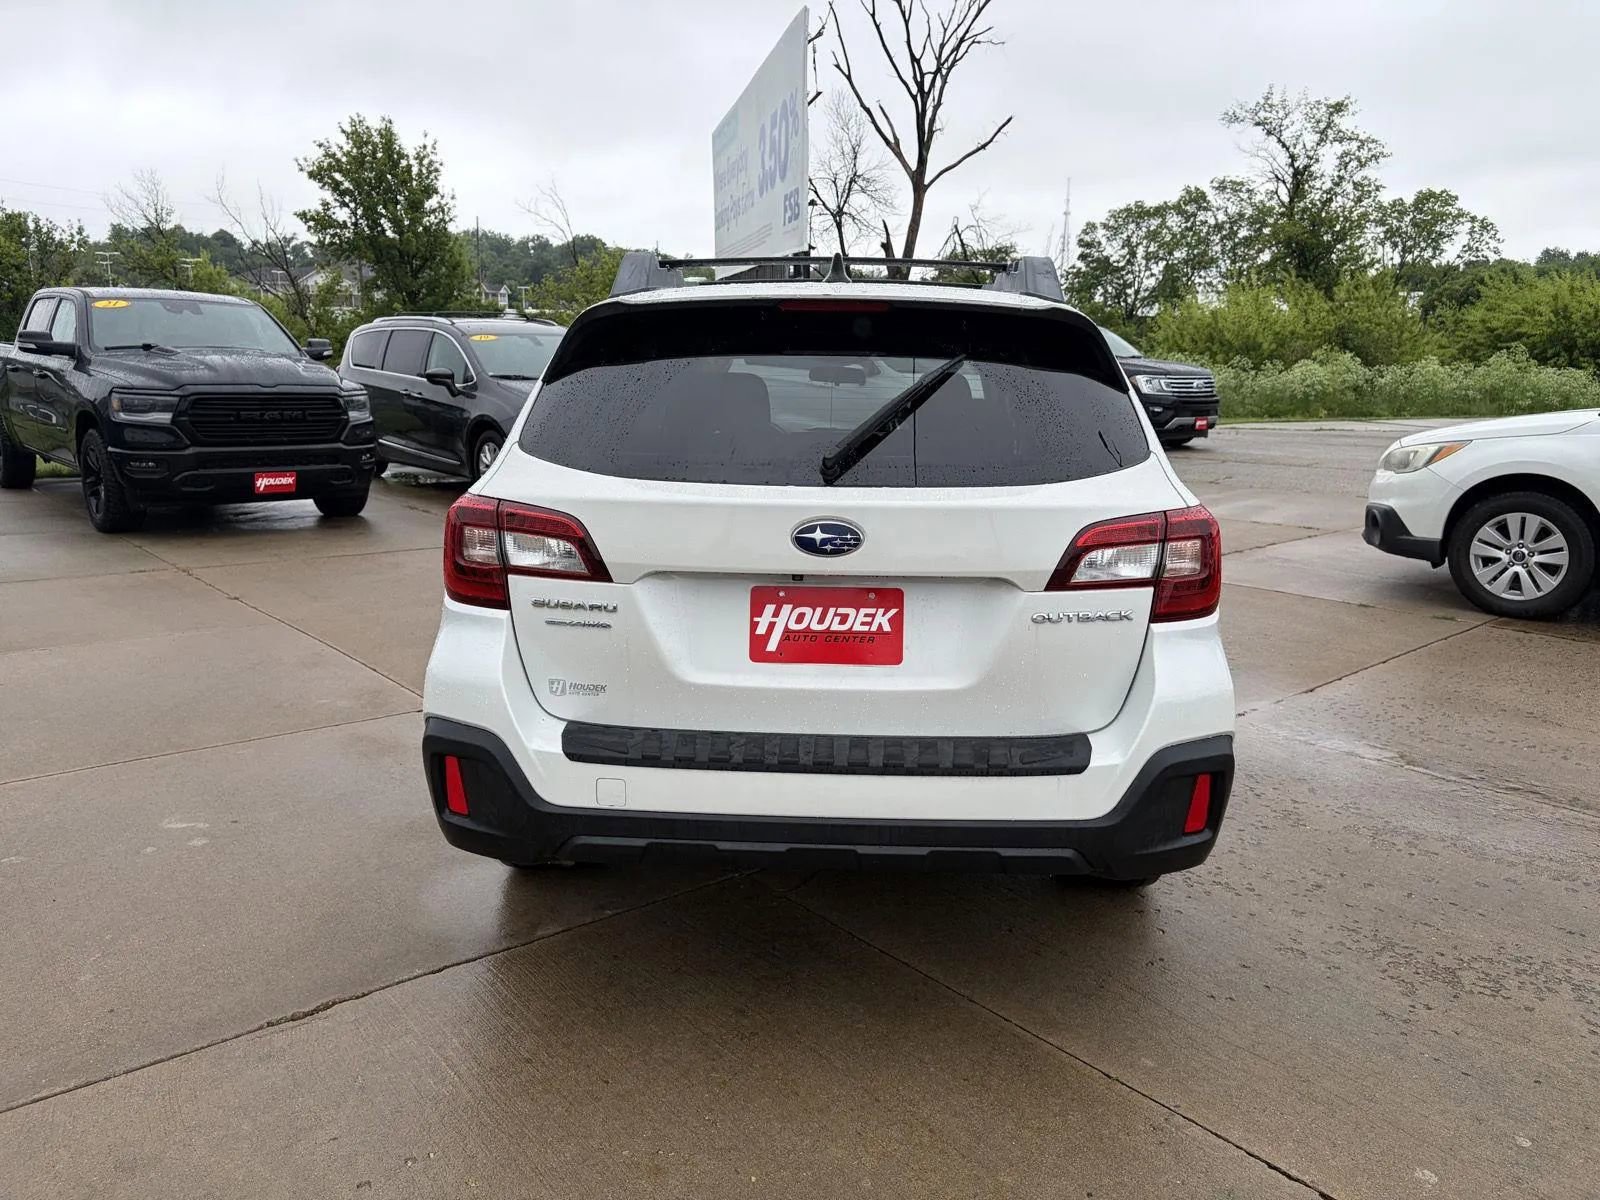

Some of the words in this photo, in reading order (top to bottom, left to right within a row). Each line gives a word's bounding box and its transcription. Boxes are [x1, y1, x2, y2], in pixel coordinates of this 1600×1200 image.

[783, 186, 801, 226] FSB
[256, 477, 295, 491] HOUDEK
[531, 598, 618, 613] SUBARU
[1031, 610, 1133, 624] OUTBACK
[753, 604, 899, 652] HOUDEK
[782, 635, 818, 643] AUTO
[824, 635, 876, 644] CENTER
[568, 682, 607, 692] HOUDEK
